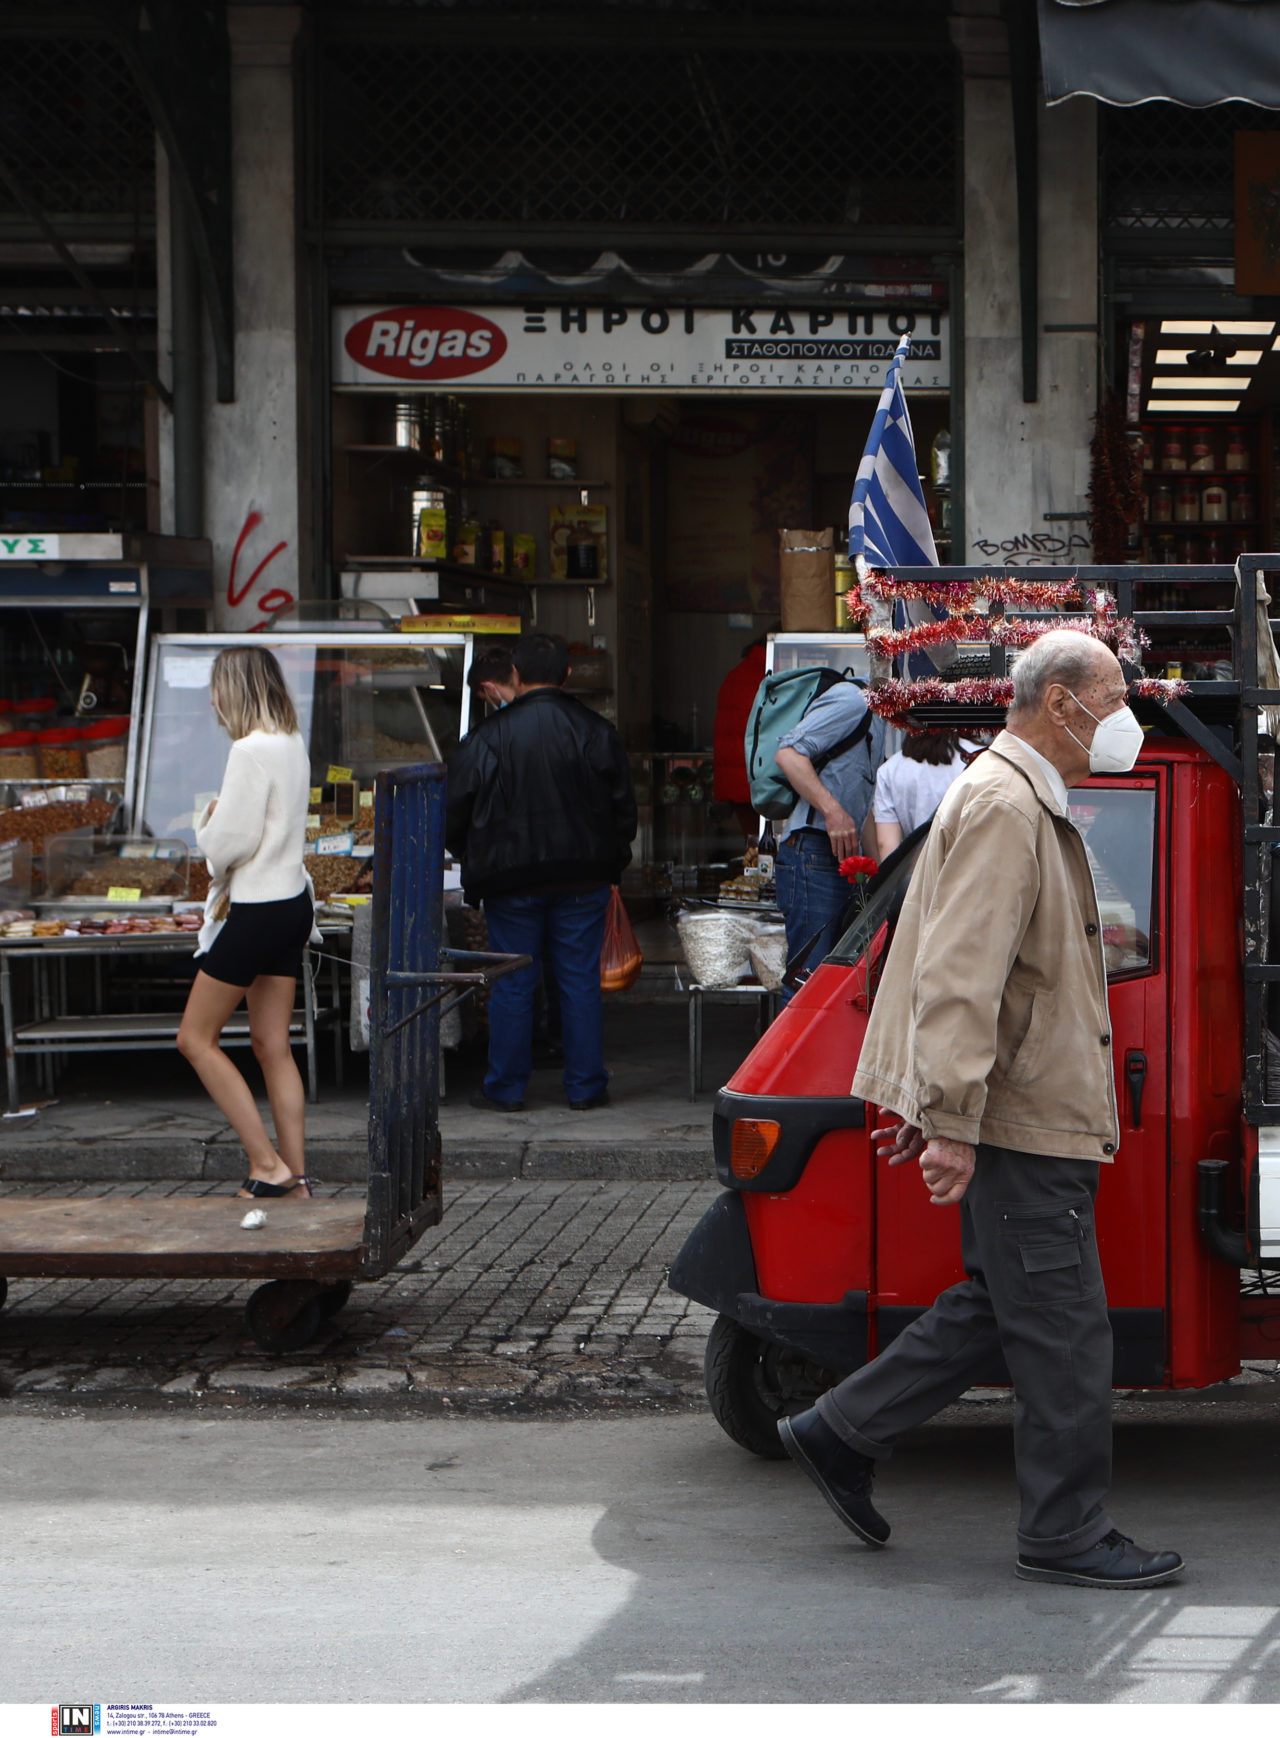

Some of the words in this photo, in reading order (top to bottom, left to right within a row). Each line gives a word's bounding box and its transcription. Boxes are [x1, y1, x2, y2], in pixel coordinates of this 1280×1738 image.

[523, 306, 694, 334] ΞΗΡΟΙ
[732, 307, 940, 336] ΚΑΡΠΟΙ
[365, 319, 494, 368] Rigas
[731, 343, 864, 357] ΣΤΑΘΟΠΟΥΛΟΥ
[868, 344, 935, 357] ΙΩΑΝΑ
[563, 362, 627, 372] ΟΛΟΙ
[651, 362, 674, 372] ΟΙ
[698, 362, 774, 373] ΞΗΡΟΙ
[516, 373, 668, 384] ΠΑΡΑΓΩΓΗΣ
[691, 374, 871, 385] ΕΡΓΟΣΤΑΣΙΟΥ
